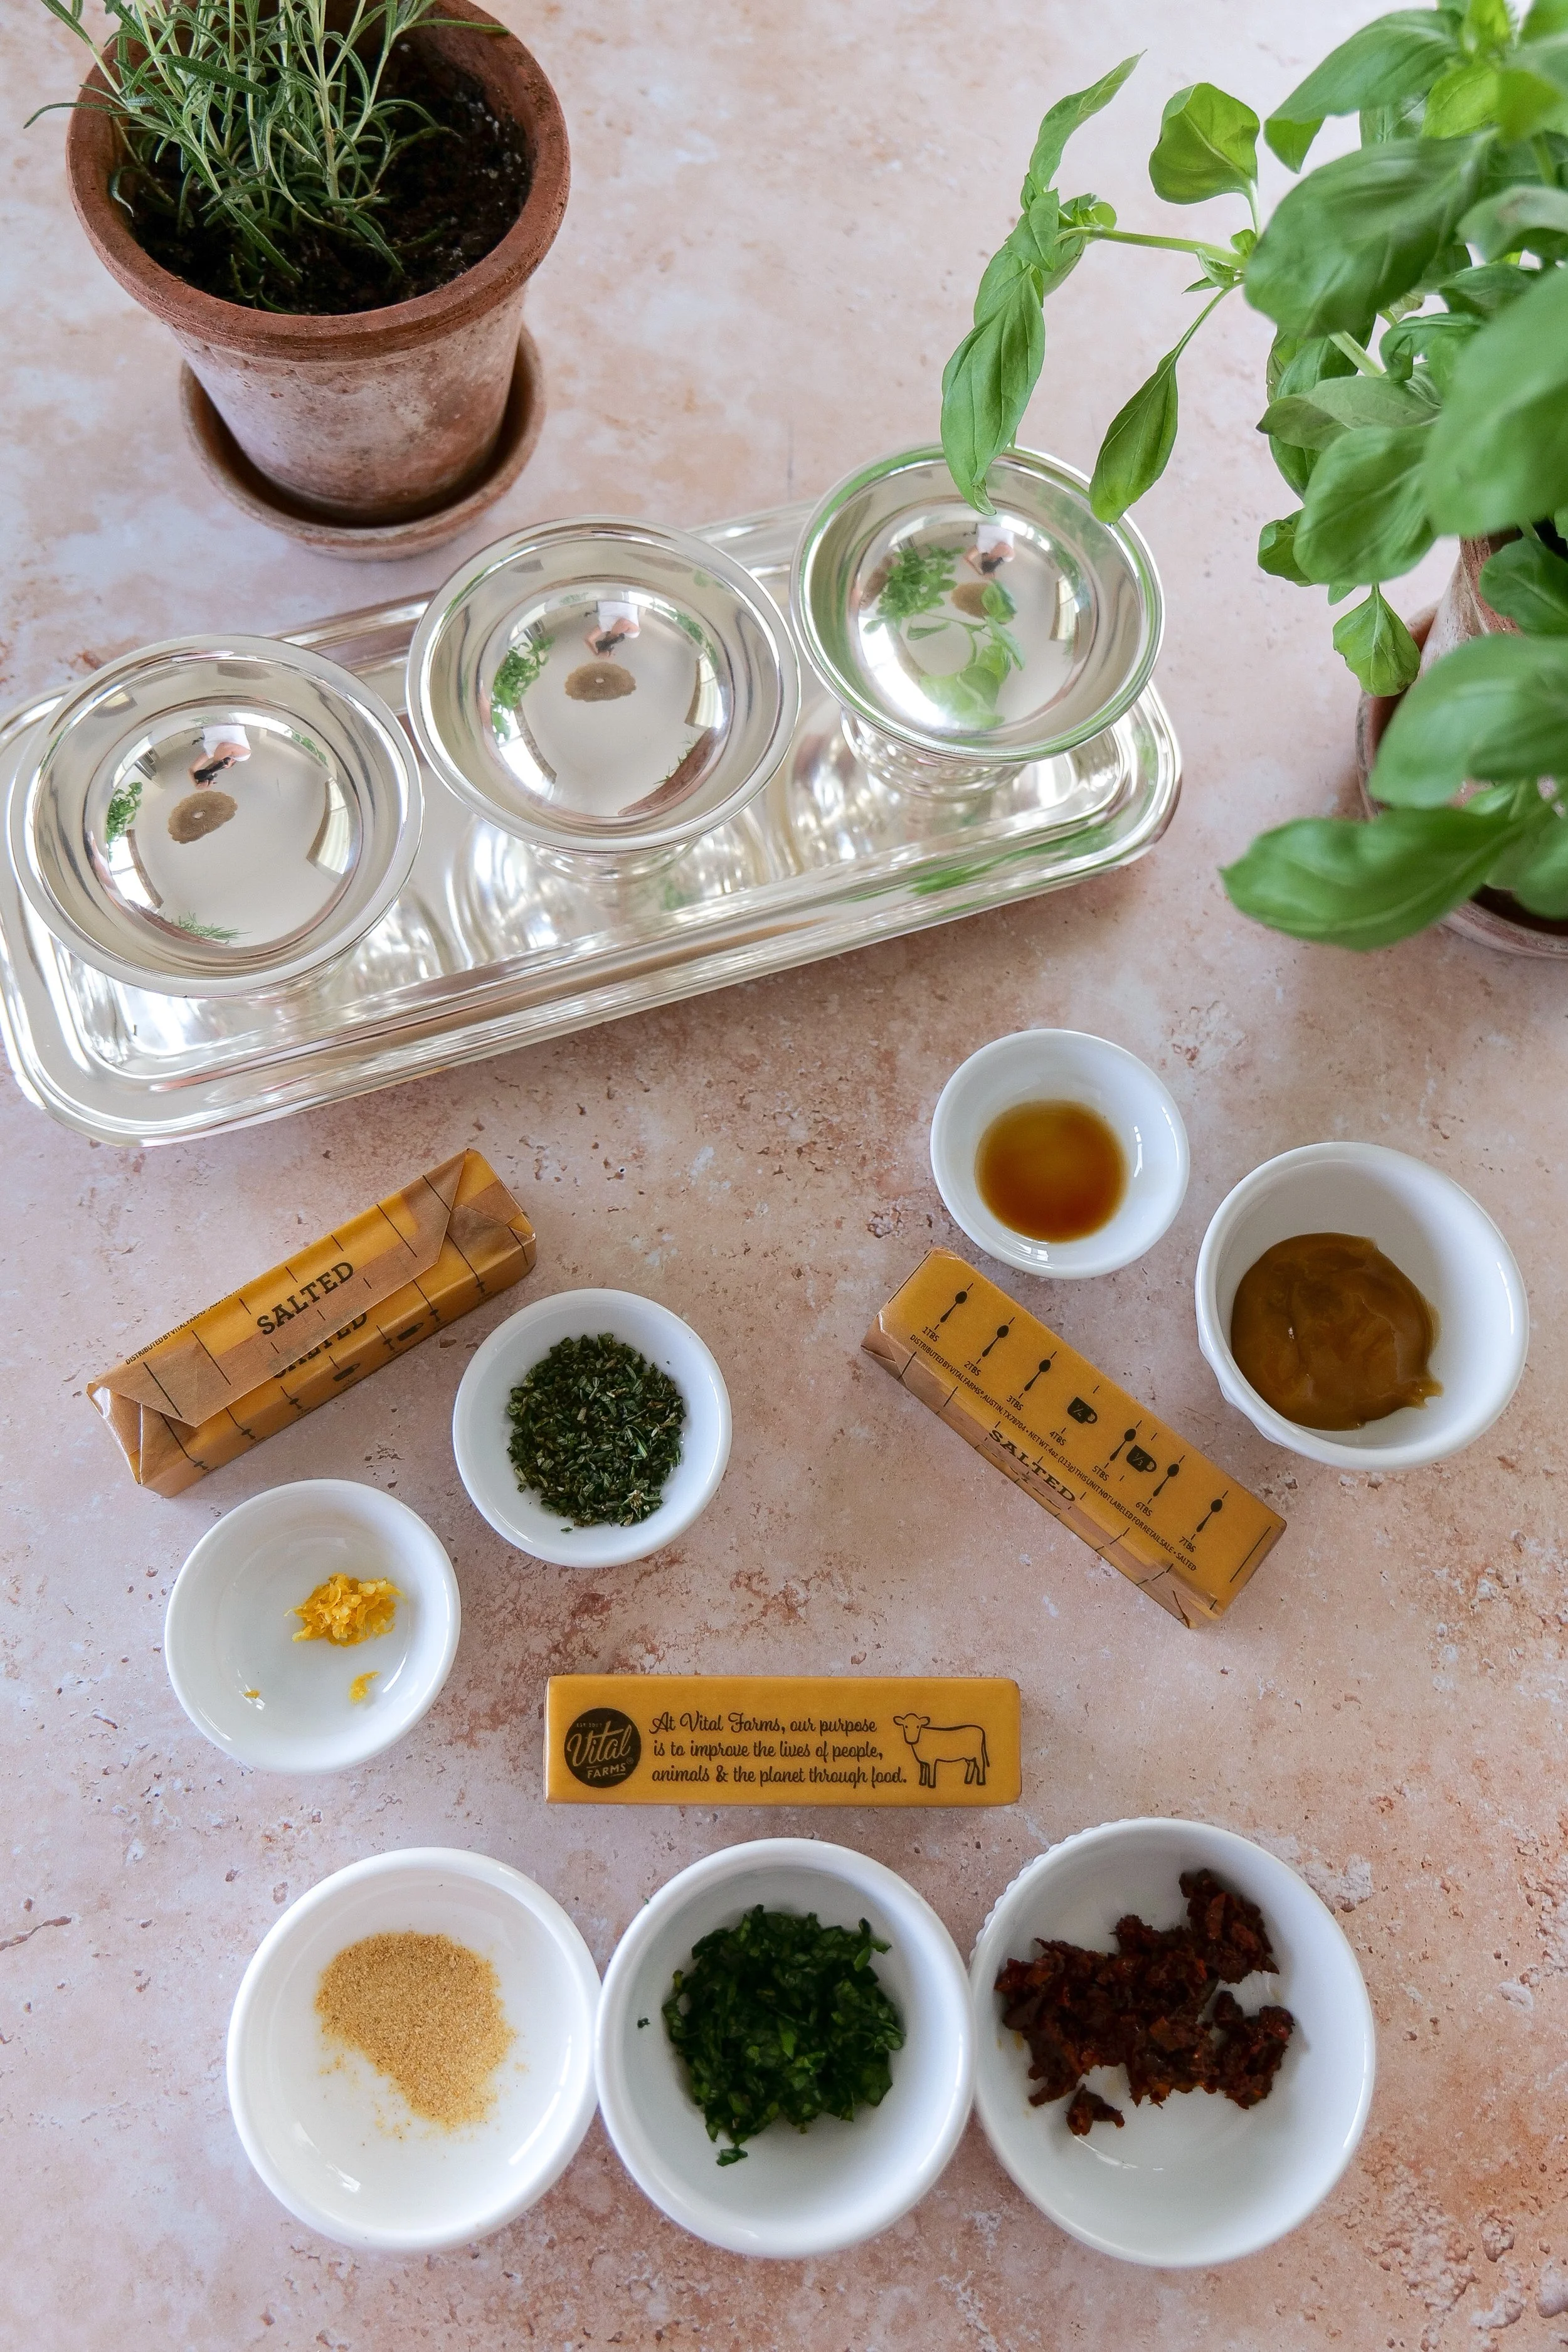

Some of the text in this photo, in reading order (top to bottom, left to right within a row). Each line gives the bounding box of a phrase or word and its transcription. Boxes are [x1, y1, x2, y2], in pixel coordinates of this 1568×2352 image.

[257, 1262, 356, 1335] SALTED
[921, 1326, 940, 1342] 1TBS
[125, 1337, 164, 1365] DISTRIBUTED
[963, 1360, 982, 1377] 2TBS
[1006, 1394, 1024, 1411] 3TBS
[1049, 1431, 1067, 1446] 4TBS
[909, 1334, 945, 1364] DISTRIBUTED
[941, 1360, 952, 1370] BY
[949, 1365, 965, 1382] VITAL
[982, 1394, 1004, 1414] AUSTIN,
[1002, 1409, 1012, 1420] TX
[1009, 1415, 1027, 1432] 78704
[1027, 1431, 1041, 1443] NET
[1074, 1468, 1089, 1482] THIS
[1086, 1478, 1101, 1492] UNIT
[1098, 1488, 1113, 1502] NOT
[1109, 1497, 1134, 1520] LABELED
[1131, 1516, 1145, 1529] FOR
[1142, 1524, 1161, 1543] RETAIL
[1158, 1539, 1175, 1554] SALE
[1175, 1552, 1197, 1571] SALTED
[988, 1429, 1076, 1502] SALTED
[1091, 1465, 1110, 1481] 5TBS
[1135, 1502, 1153, 1517] 6TBS
[1179, 1535, 1197, 1553] 7TBS
[649, 1710, 877, 1737] At Vital Farms, our purpose
[567, 1721, 632, 1766] Vital
[653, 1739, 883, 1763] is to improve the lives of people,
[652, 1765, 907, 1789] animals & the planet through food.
